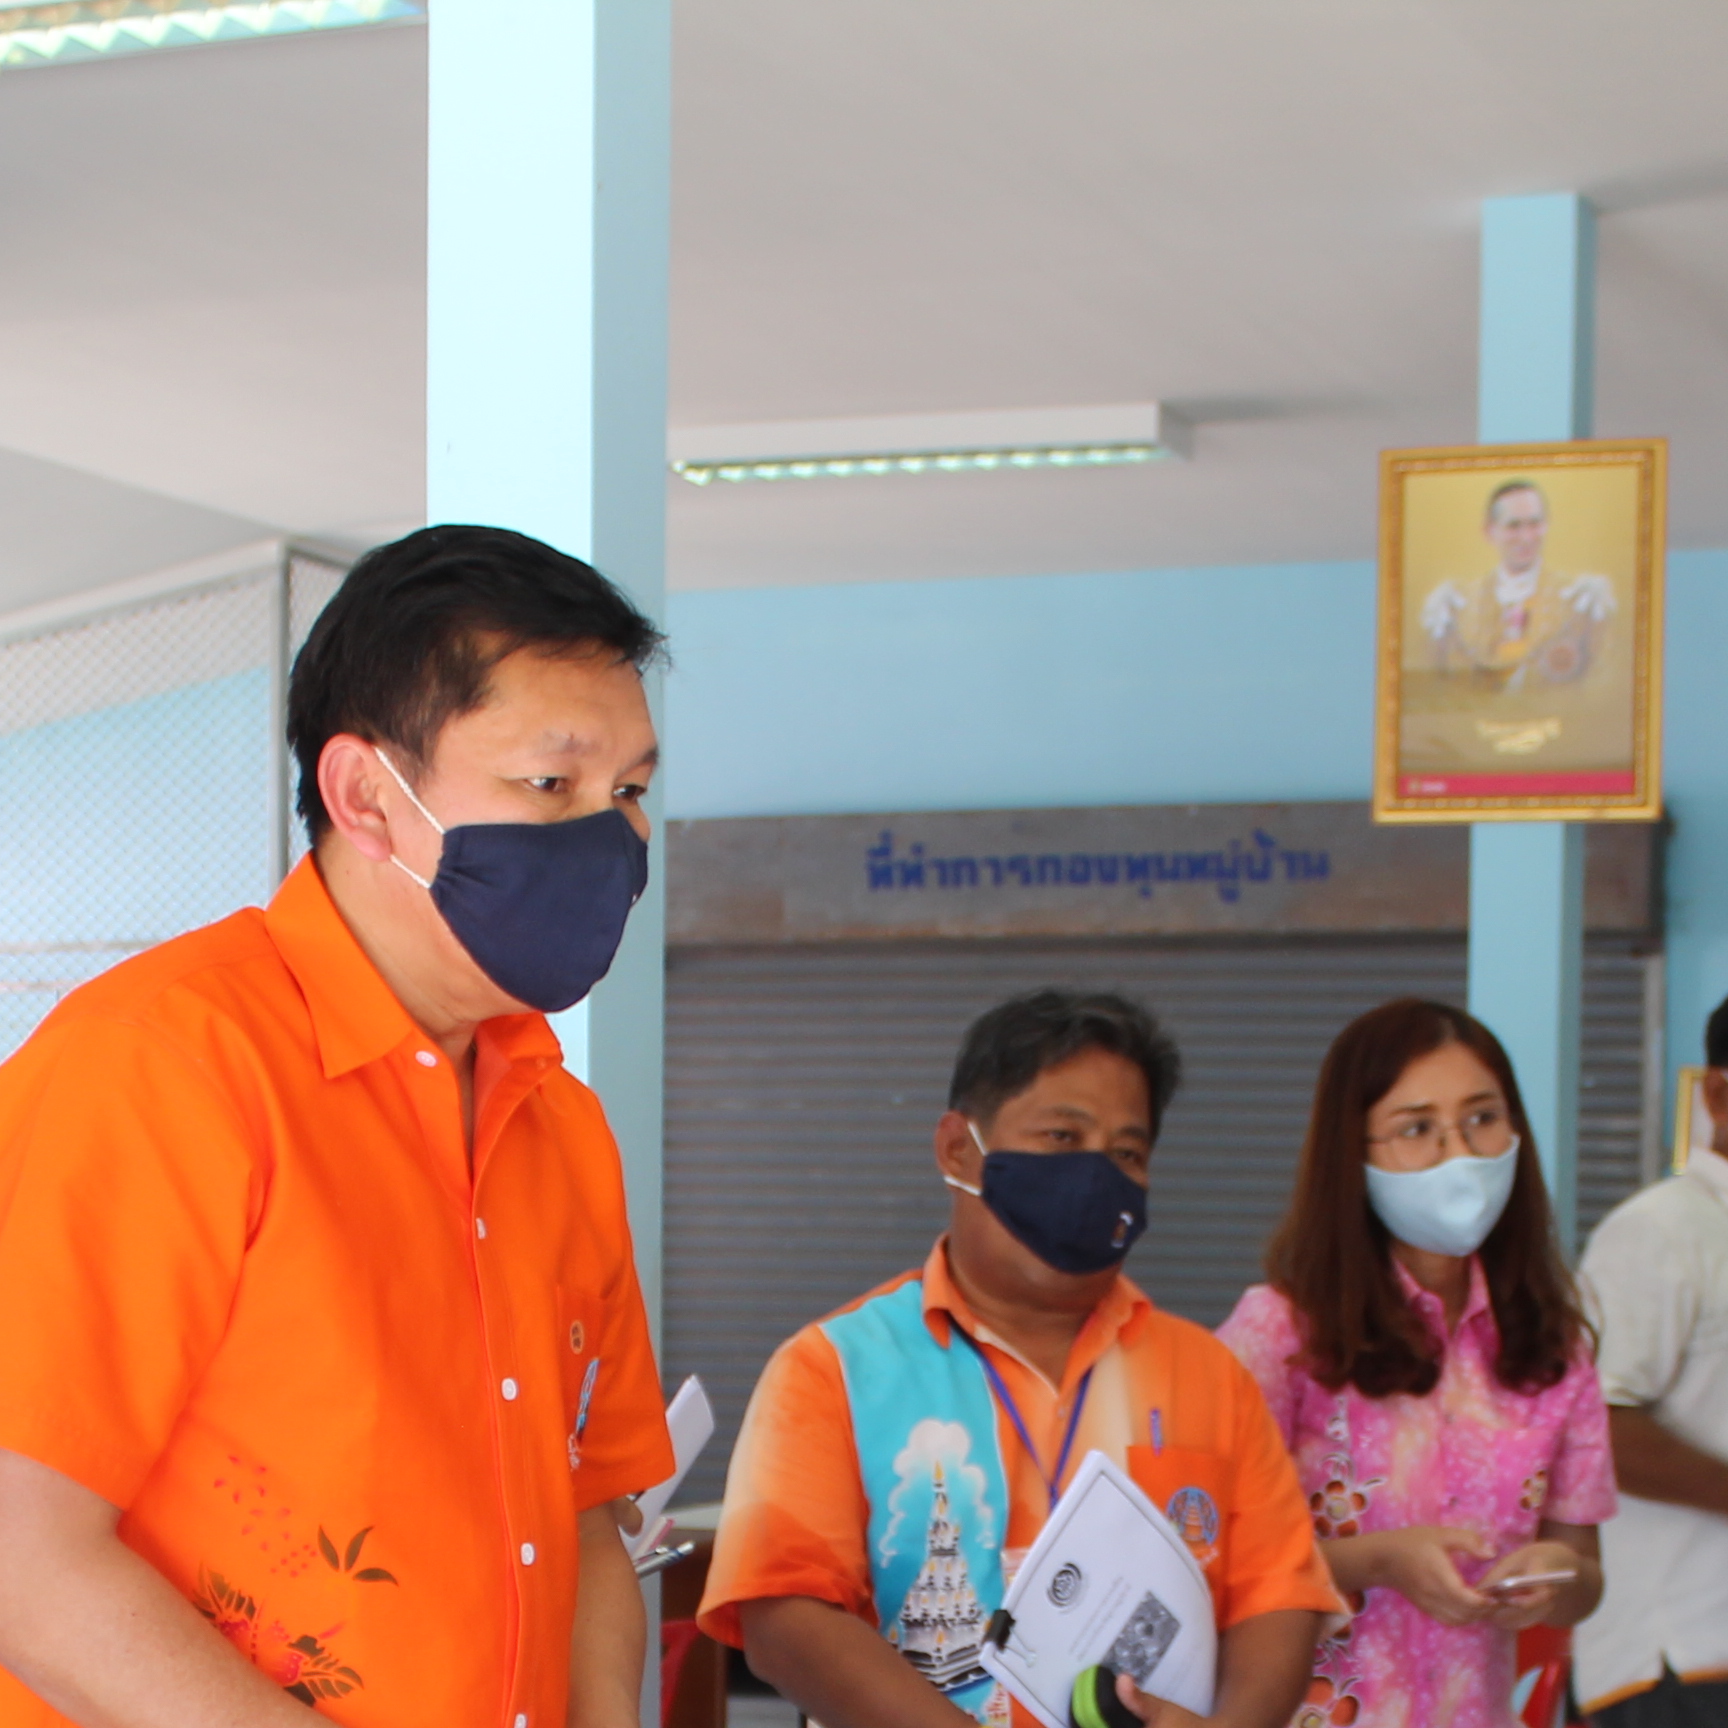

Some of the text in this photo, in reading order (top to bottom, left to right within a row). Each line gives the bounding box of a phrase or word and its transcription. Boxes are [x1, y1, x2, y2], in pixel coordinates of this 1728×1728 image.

[866, 828, 1332, 905] ที่ทำการกองทุนหมู่บ้าน
